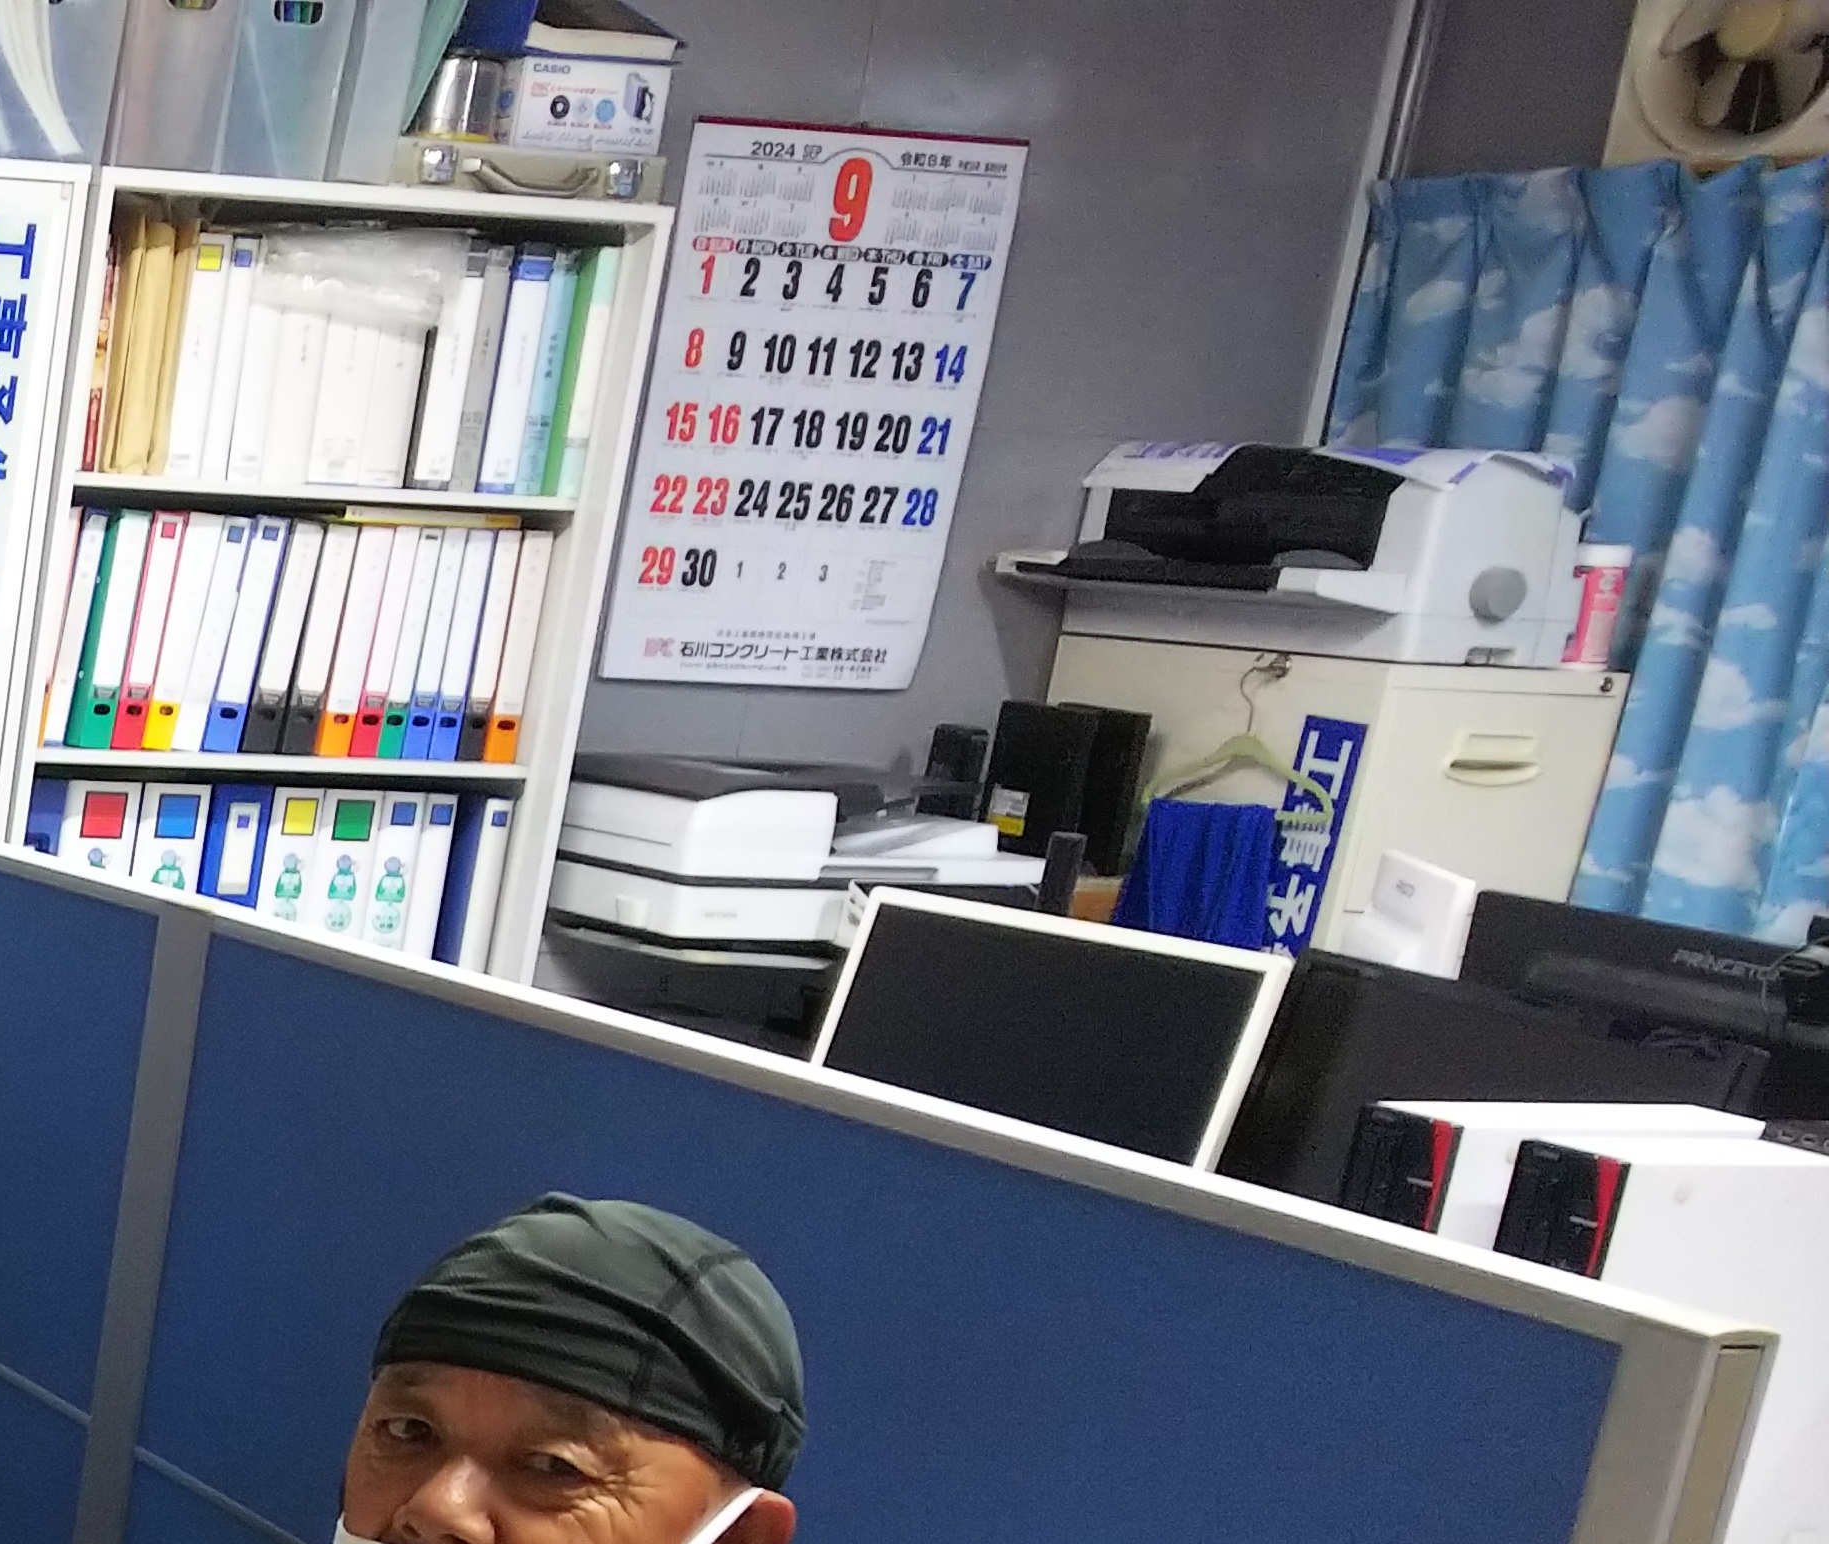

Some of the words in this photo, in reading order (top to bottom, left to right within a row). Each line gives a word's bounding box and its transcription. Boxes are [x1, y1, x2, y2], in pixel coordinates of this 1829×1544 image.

[533, 63, 571, 75] CASIO
[751, 141, 795, 159] 2024
[828, 156, 874, 242] 9
[702, 253, 716, 293] 1
[739, 257, 761, 297] 2
[782, 259, 803, 300] 3
[825, 263, 845, 303] 4
[867, 265, 889, 306] 5
[911, 268, 933, 309] 6
[956, 271, 976, 311] 7
[684, 328, 705, 369] 8
[726, 330, 747, 371] 9
[763, 334, 797, 374] 10
[807, 337, 838, 376] 11
[849, 338, 882, 379] 12
[891, 341, 925, 382] 13
[935, 345, 966, 382] 14
[667, 402, 699, 443] 15
[708, 404, 741, 445] 16
[750, 406, 784, 446] 17
[793, 409, 826, 449] 18
[835, 411, 869, 451] 19
[873, 413, 912, 454] 20
[917, 416, 950, 456] 21
[650, 475, 688, 514] 22
[692, 476, 730, 516] 23
[734, 478, 771, 518] 24
[775, 481, 813, 521] 25
[817, 483, 856, 523] 26
[859, 485, 899, 524] 27
[901, 489, 938, 528] 28
[639, 546, 676, 586] 29
[681, 548, 718, 588] 30
[777, 562, 787, 580] 2
[819, 564, 829, 582] 3
[1263, 730, 1353, 959] 工事予
